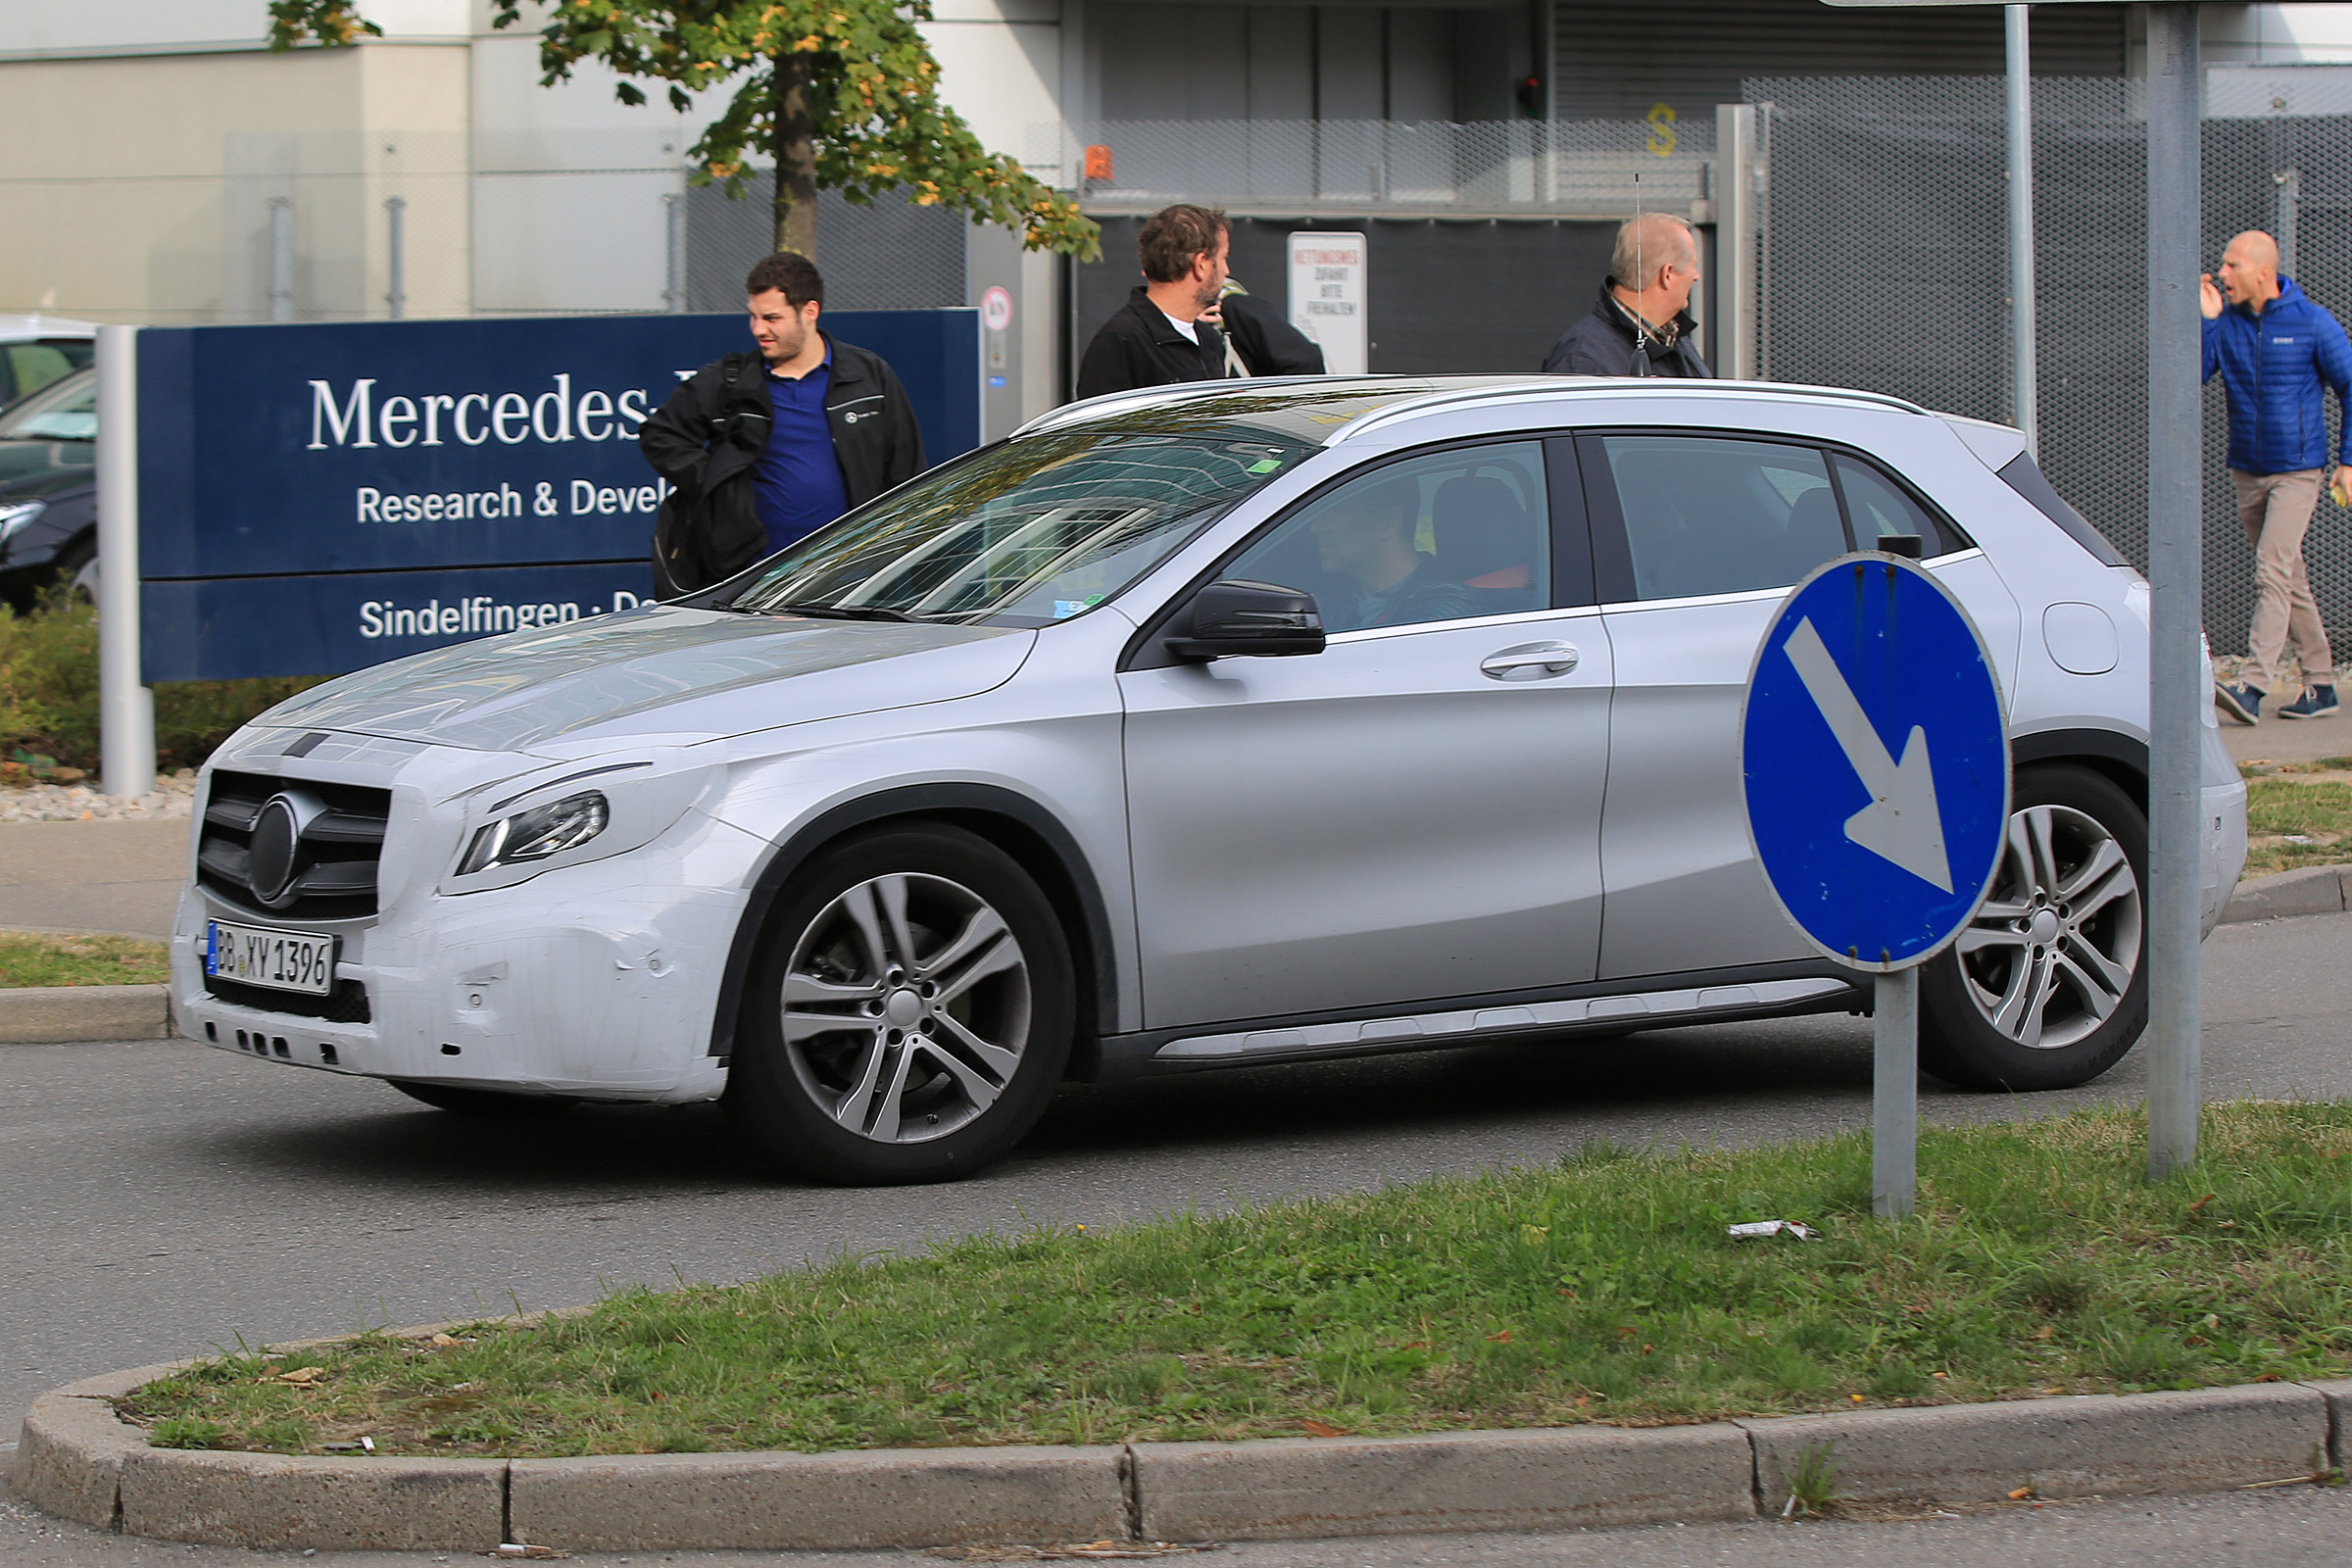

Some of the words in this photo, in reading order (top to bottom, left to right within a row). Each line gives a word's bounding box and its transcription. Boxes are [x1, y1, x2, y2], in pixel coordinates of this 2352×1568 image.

[307, 370, 697, 451] Mercedes
[357, 481, 523, 523] Research
[533, 481, 559, 517] &
[570, 476, 677, 515] Devel
[360, 596, 580, 638] Sindelfingen
[218, 929, 235, 972] BB
[246, 935, 270, 978] XY
[274, 938, 329, 986] 1396
